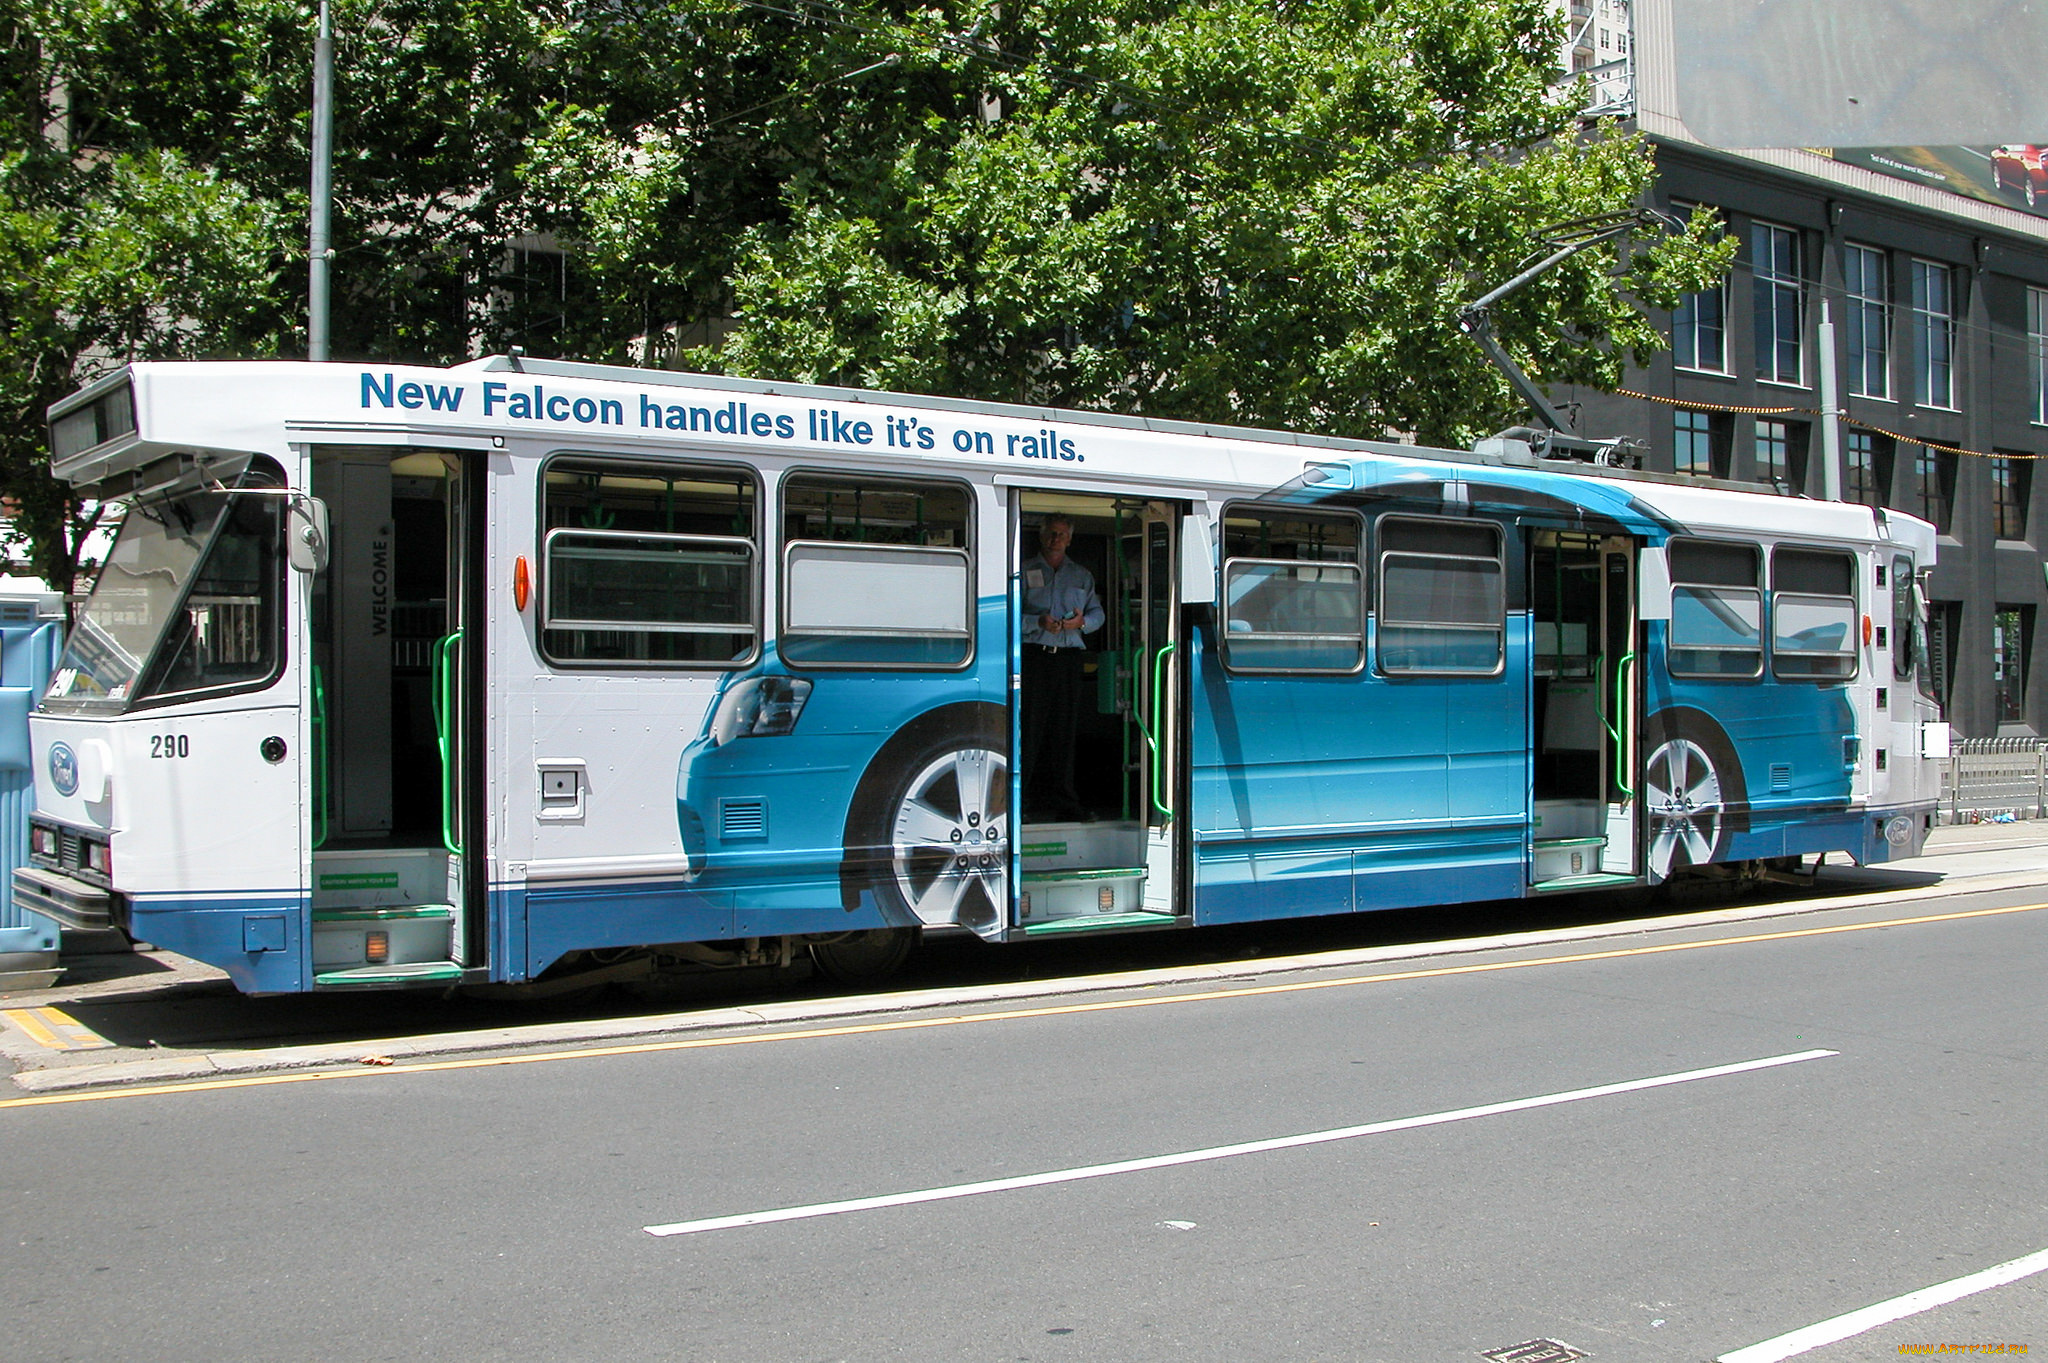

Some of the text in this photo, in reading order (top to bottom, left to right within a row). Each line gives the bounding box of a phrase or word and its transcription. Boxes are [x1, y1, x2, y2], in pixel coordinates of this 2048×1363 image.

[360, 372, 1085, 462] New Falcon handles like it's on rails.
[372, 541, 387, 636] WELCOME
[1933, 618, 1943, 690] Furniture
[52, 749, 74, 788] Ford
[151, 734, 189, 759] 290
